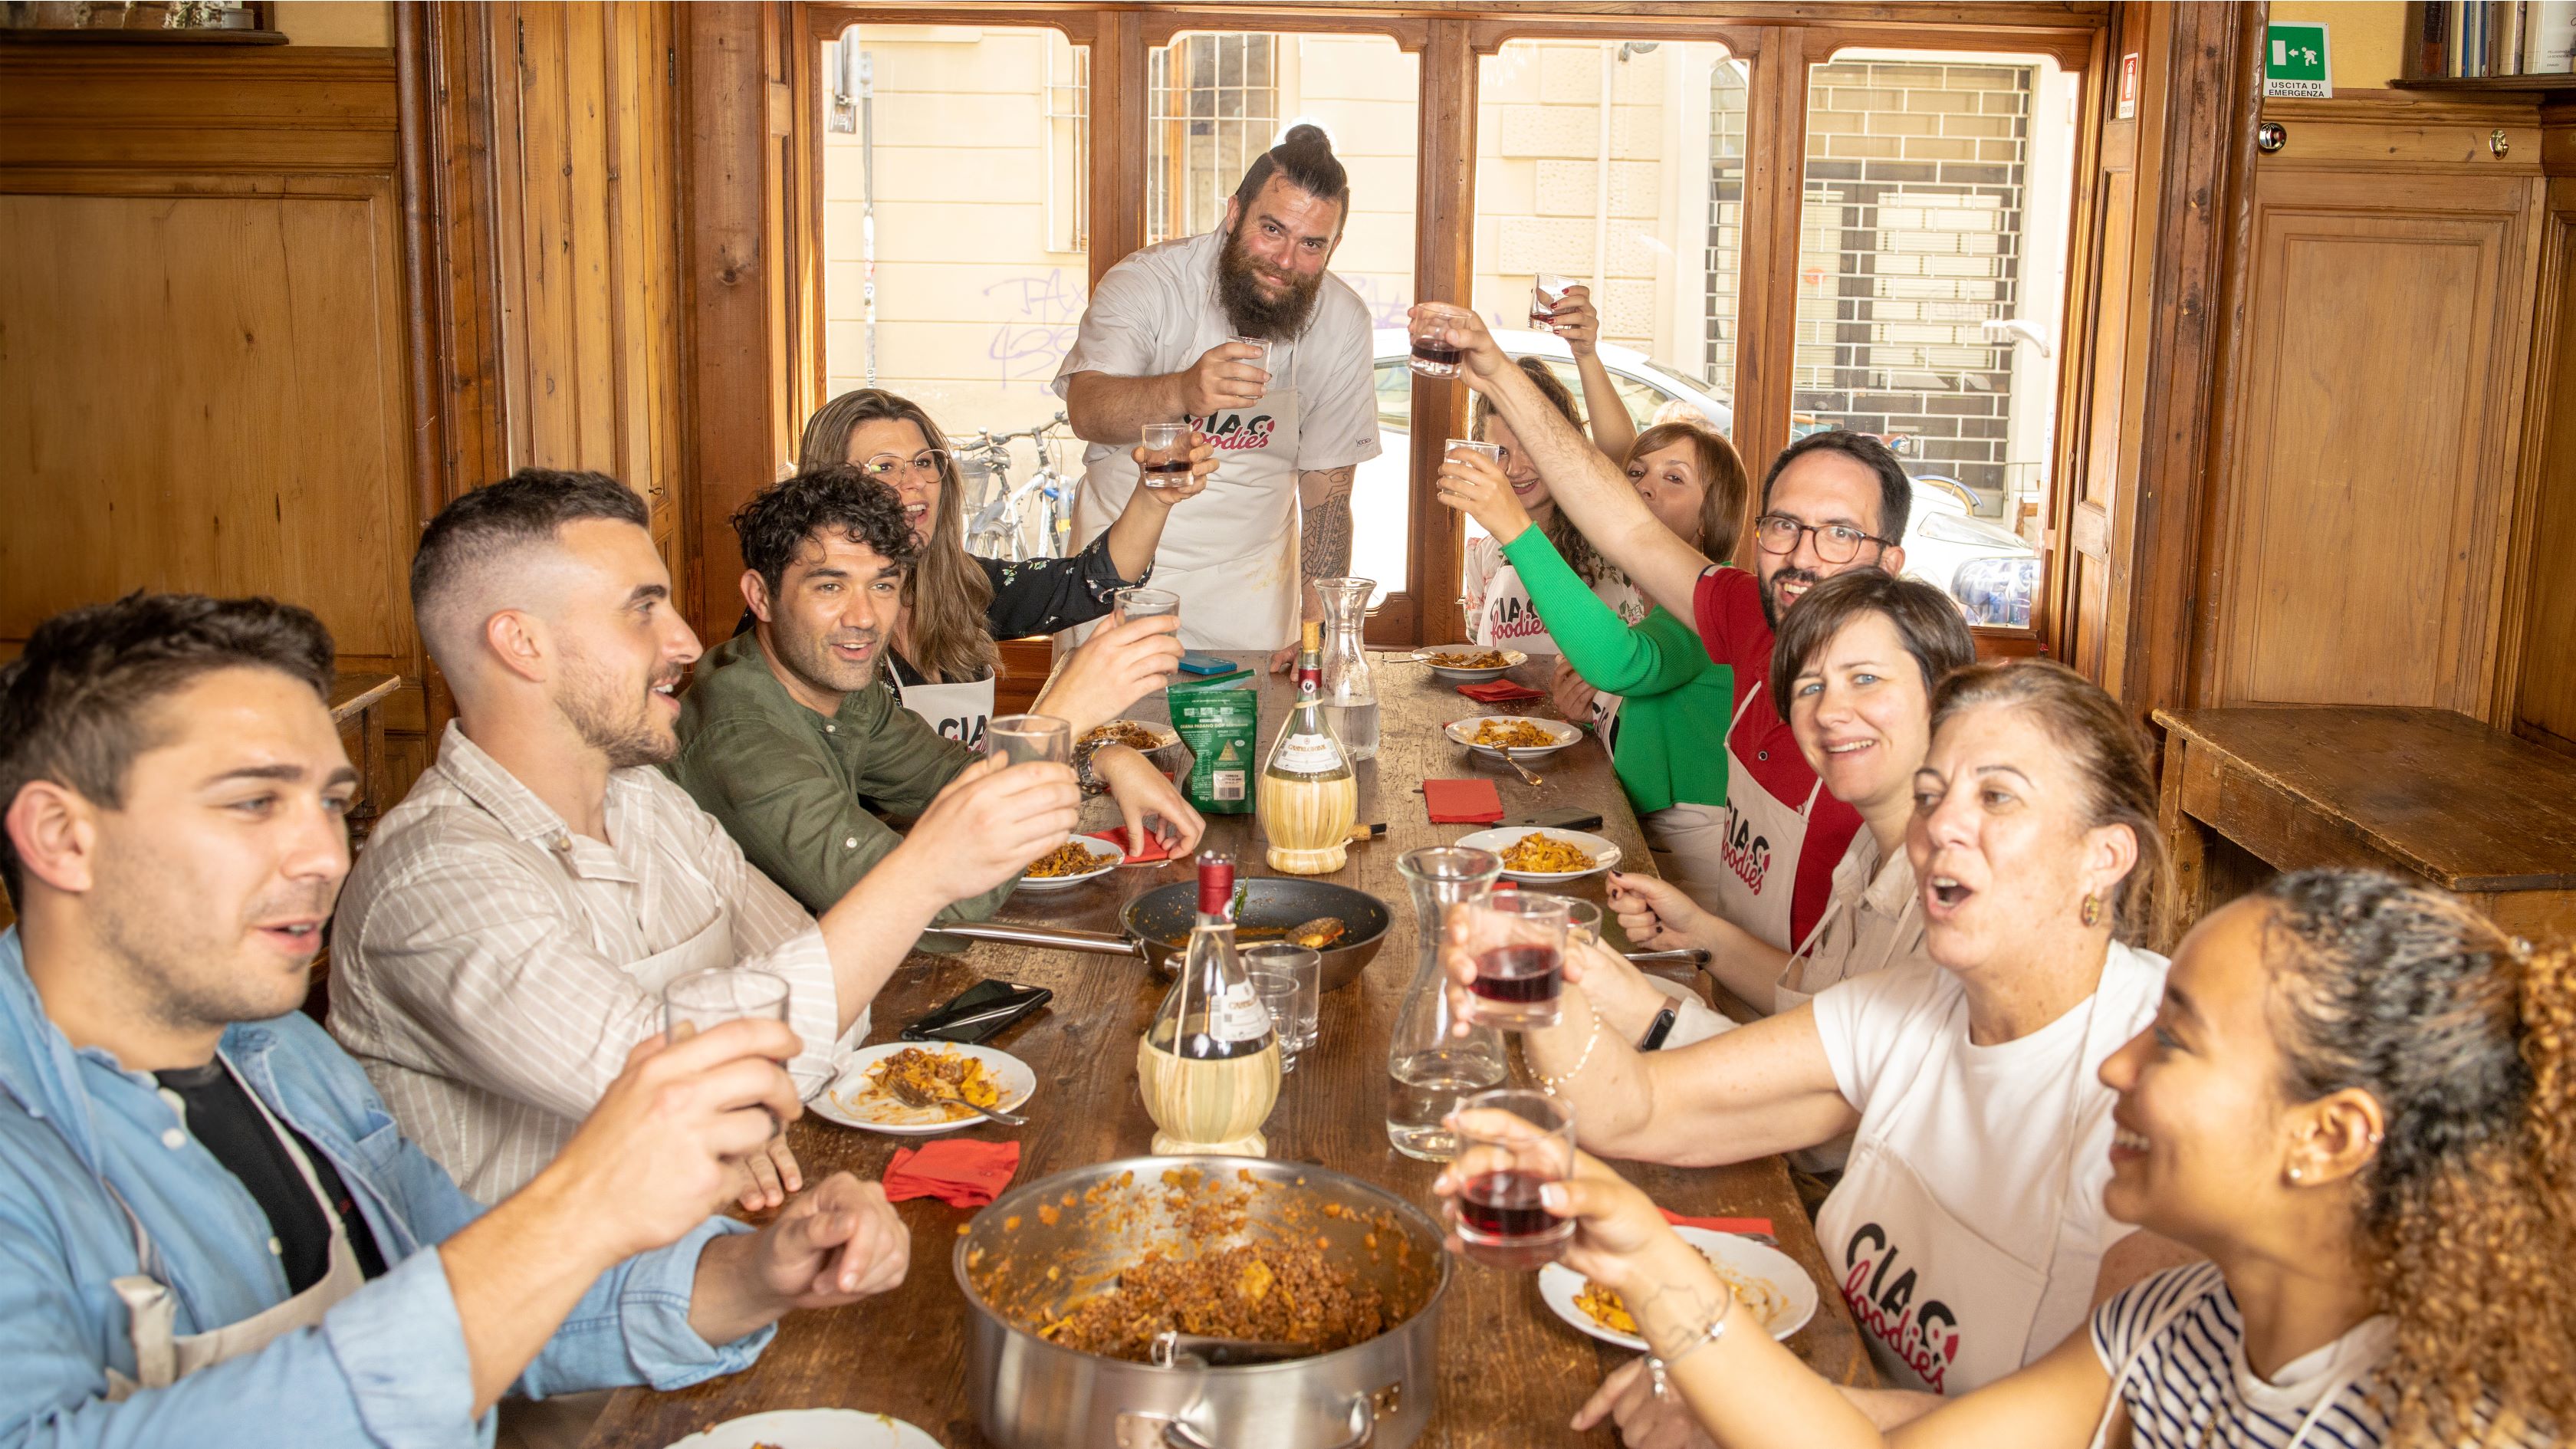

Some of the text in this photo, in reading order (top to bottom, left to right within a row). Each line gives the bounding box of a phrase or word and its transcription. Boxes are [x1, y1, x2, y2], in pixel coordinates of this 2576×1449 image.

[1184, 411, 1275, 439] IAO
[938, 715, 988, 747] CIA
[1842, 1260, 1945, 1395] foodies
[1846, 1223, 1960, 1366] CIAO
